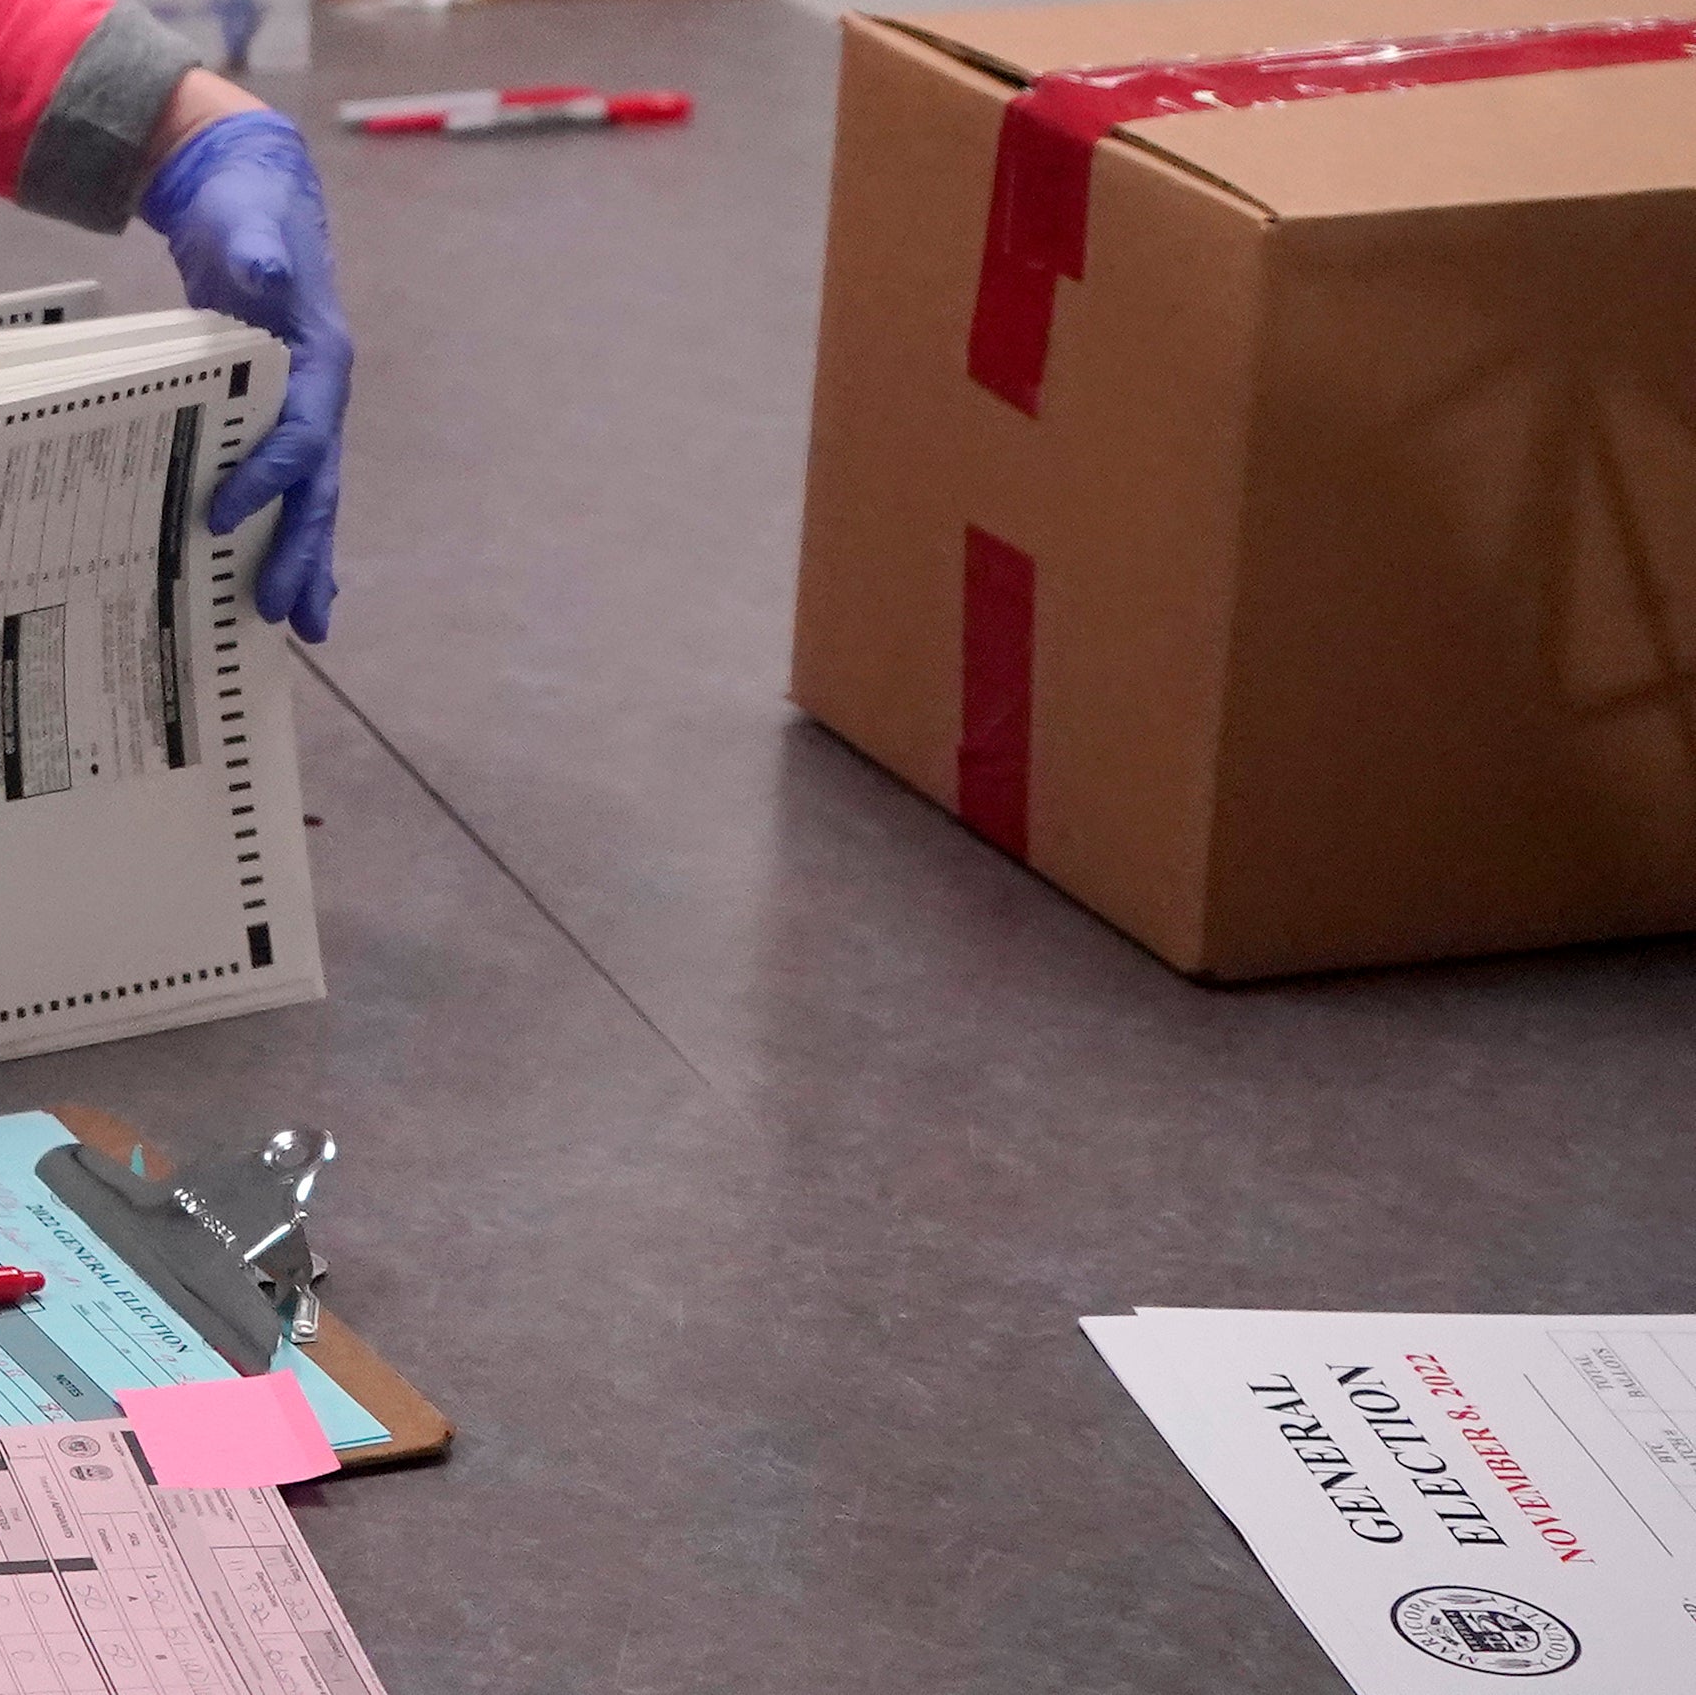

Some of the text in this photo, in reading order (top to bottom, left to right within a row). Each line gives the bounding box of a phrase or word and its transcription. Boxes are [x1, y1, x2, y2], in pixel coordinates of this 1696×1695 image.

[23, 1203, 62, 1228] 2022
[48, 1229, 123, 1285] GENERAL
[111, 1291, 194, 1354] ELECTION
[50, 1374, 86, 1397] NOTES
[1405, 1353, 1463, 1398] 2022
[1575, 1354, 1614, 1391] TOTAL
[1592, 1346, 1647, 1399] BALLOTS
[1246, 1373, 1403, 1543] GENERAL
[1325, 1363, 1509, 1547] ELECTION
[1645, 1440, 1677, 1464] BTC
[47, 1501, 77, 1538] AFFIDAVITS
[1461, 1427, 1597, 1565] NOVEMBER
[1403, 1598, 1478, 1665] MARICOPA
[1507, 1603, 1569, 1661] COUNTY
